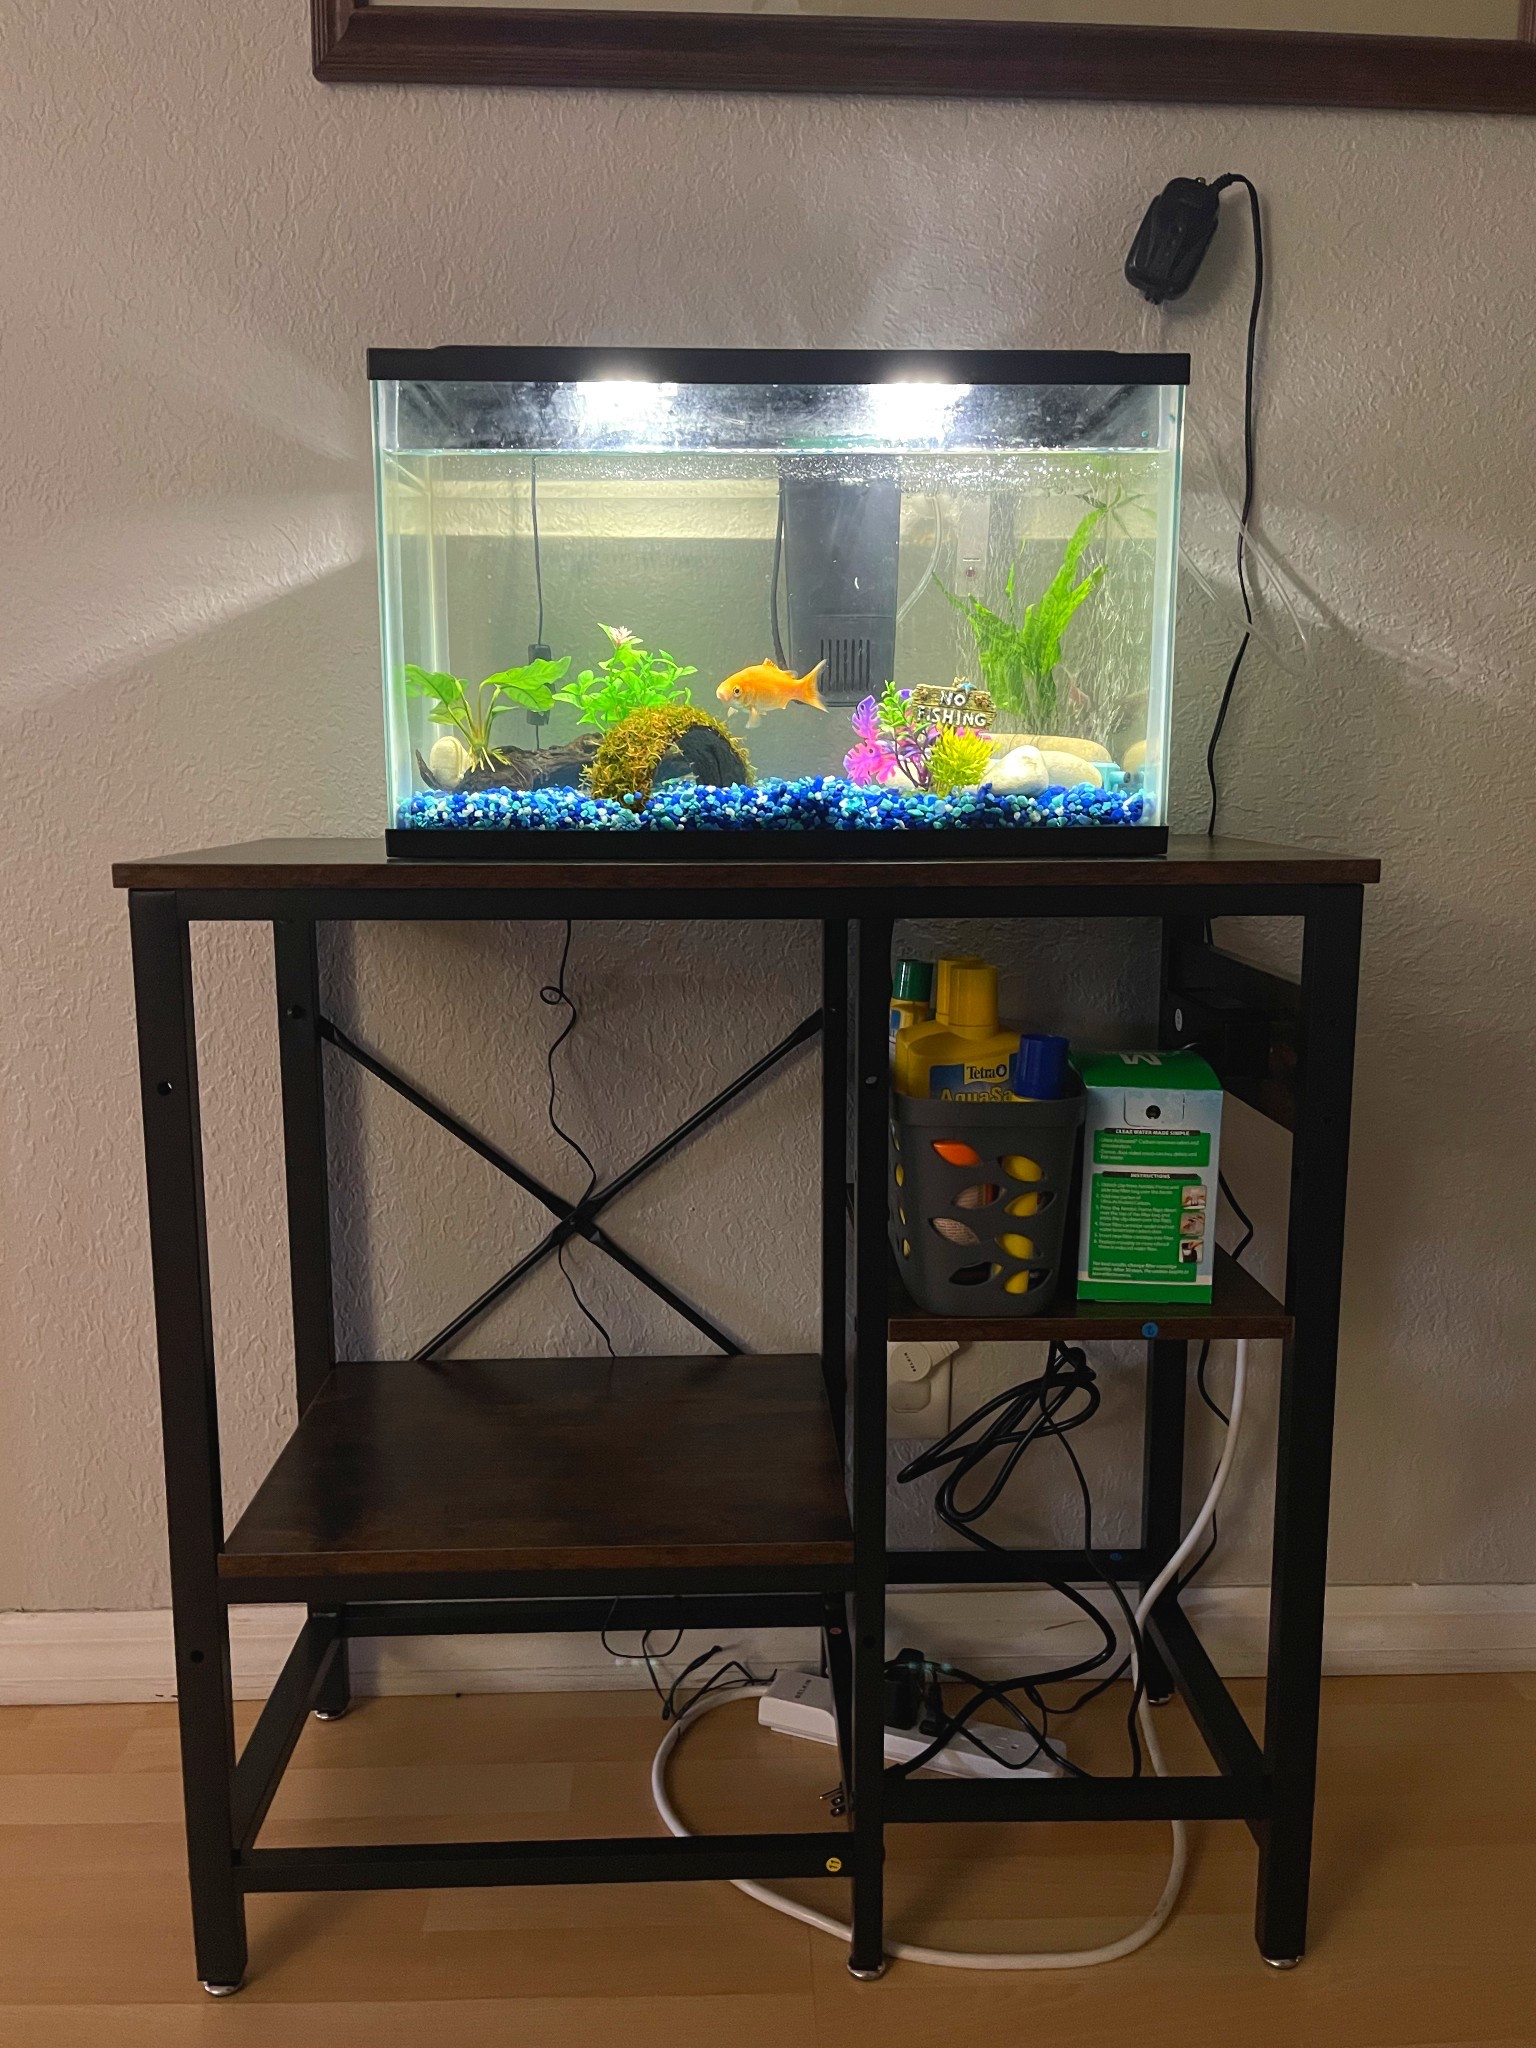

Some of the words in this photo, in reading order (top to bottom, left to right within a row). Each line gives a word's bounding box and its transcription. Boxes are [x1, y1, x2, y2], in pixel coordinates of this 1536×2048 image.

[940, 690, 966, 706] NO
[917, 705, 987, 727] FISHING
[966, 1065, 996, 1080] Tetra
